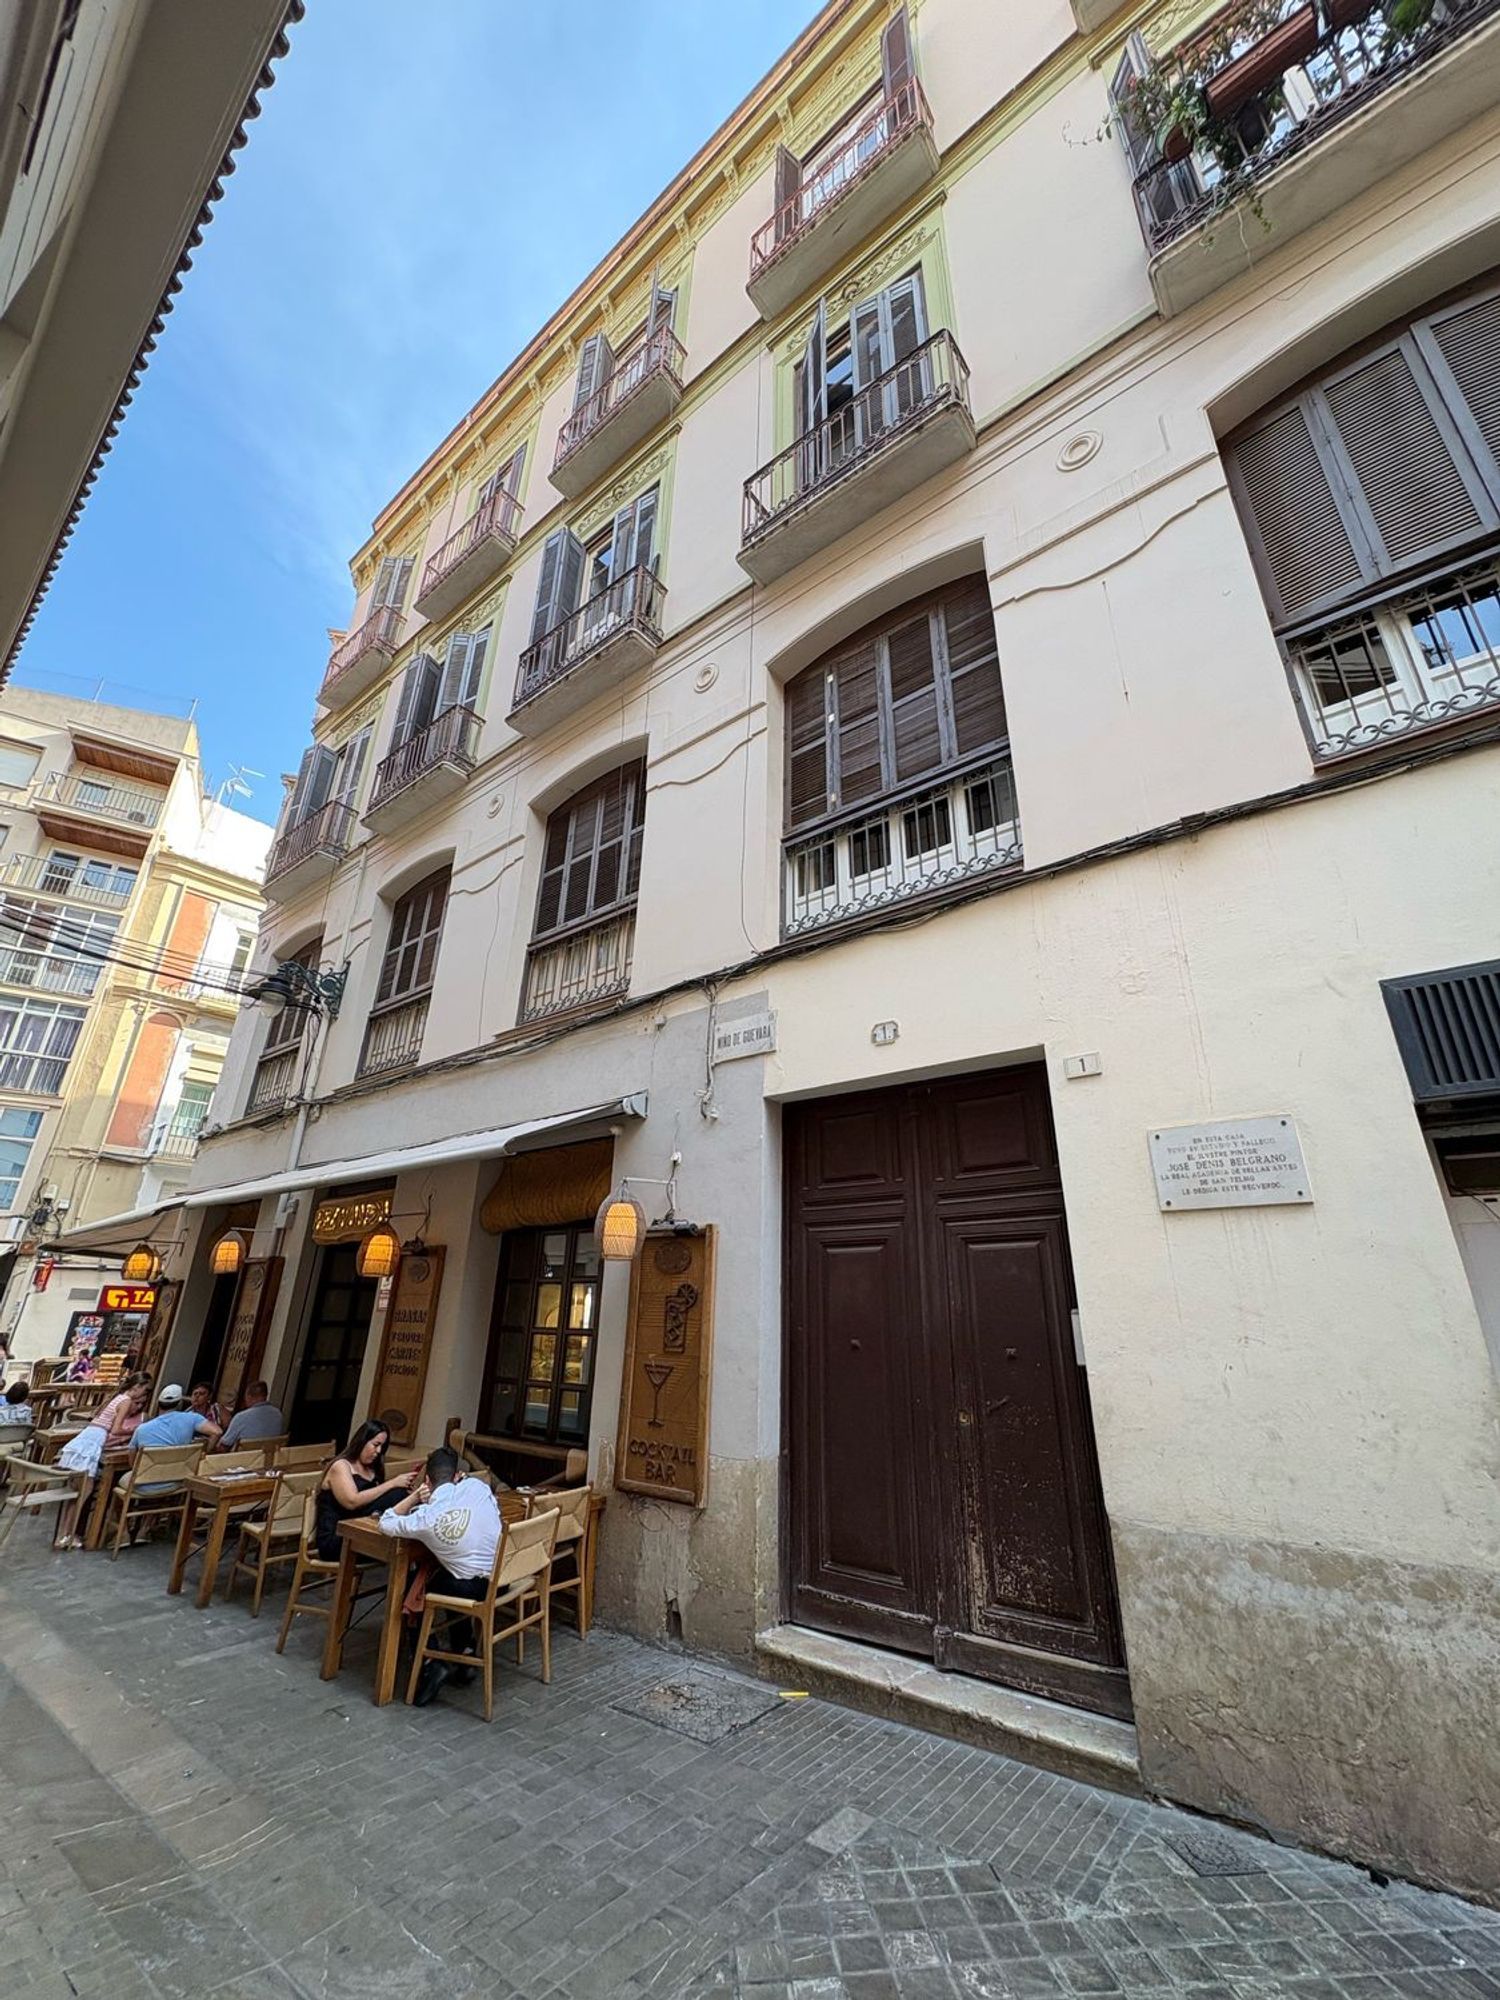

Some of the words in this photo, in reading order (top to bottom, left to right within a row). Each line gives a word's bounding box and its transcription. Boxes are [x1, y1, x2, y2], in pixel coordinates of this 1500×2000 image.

[732, 1031, 742, 1046] DE
[742, 1024, 771, 1044] GUEVARA
[1079, 1058, 1086, 1072] 1
[1196, 1160, 1224, 1170] DENIS
[1230, 1154, 1287, 1167] BELGRANO
[1230, 1175, 1256, 1183] TELMO
[1222, 1185, 1239, 1193] ESTE
[630, 1439, 696, 1465] COCKTAIL
[644, 1461, 676, 1485] BAR
